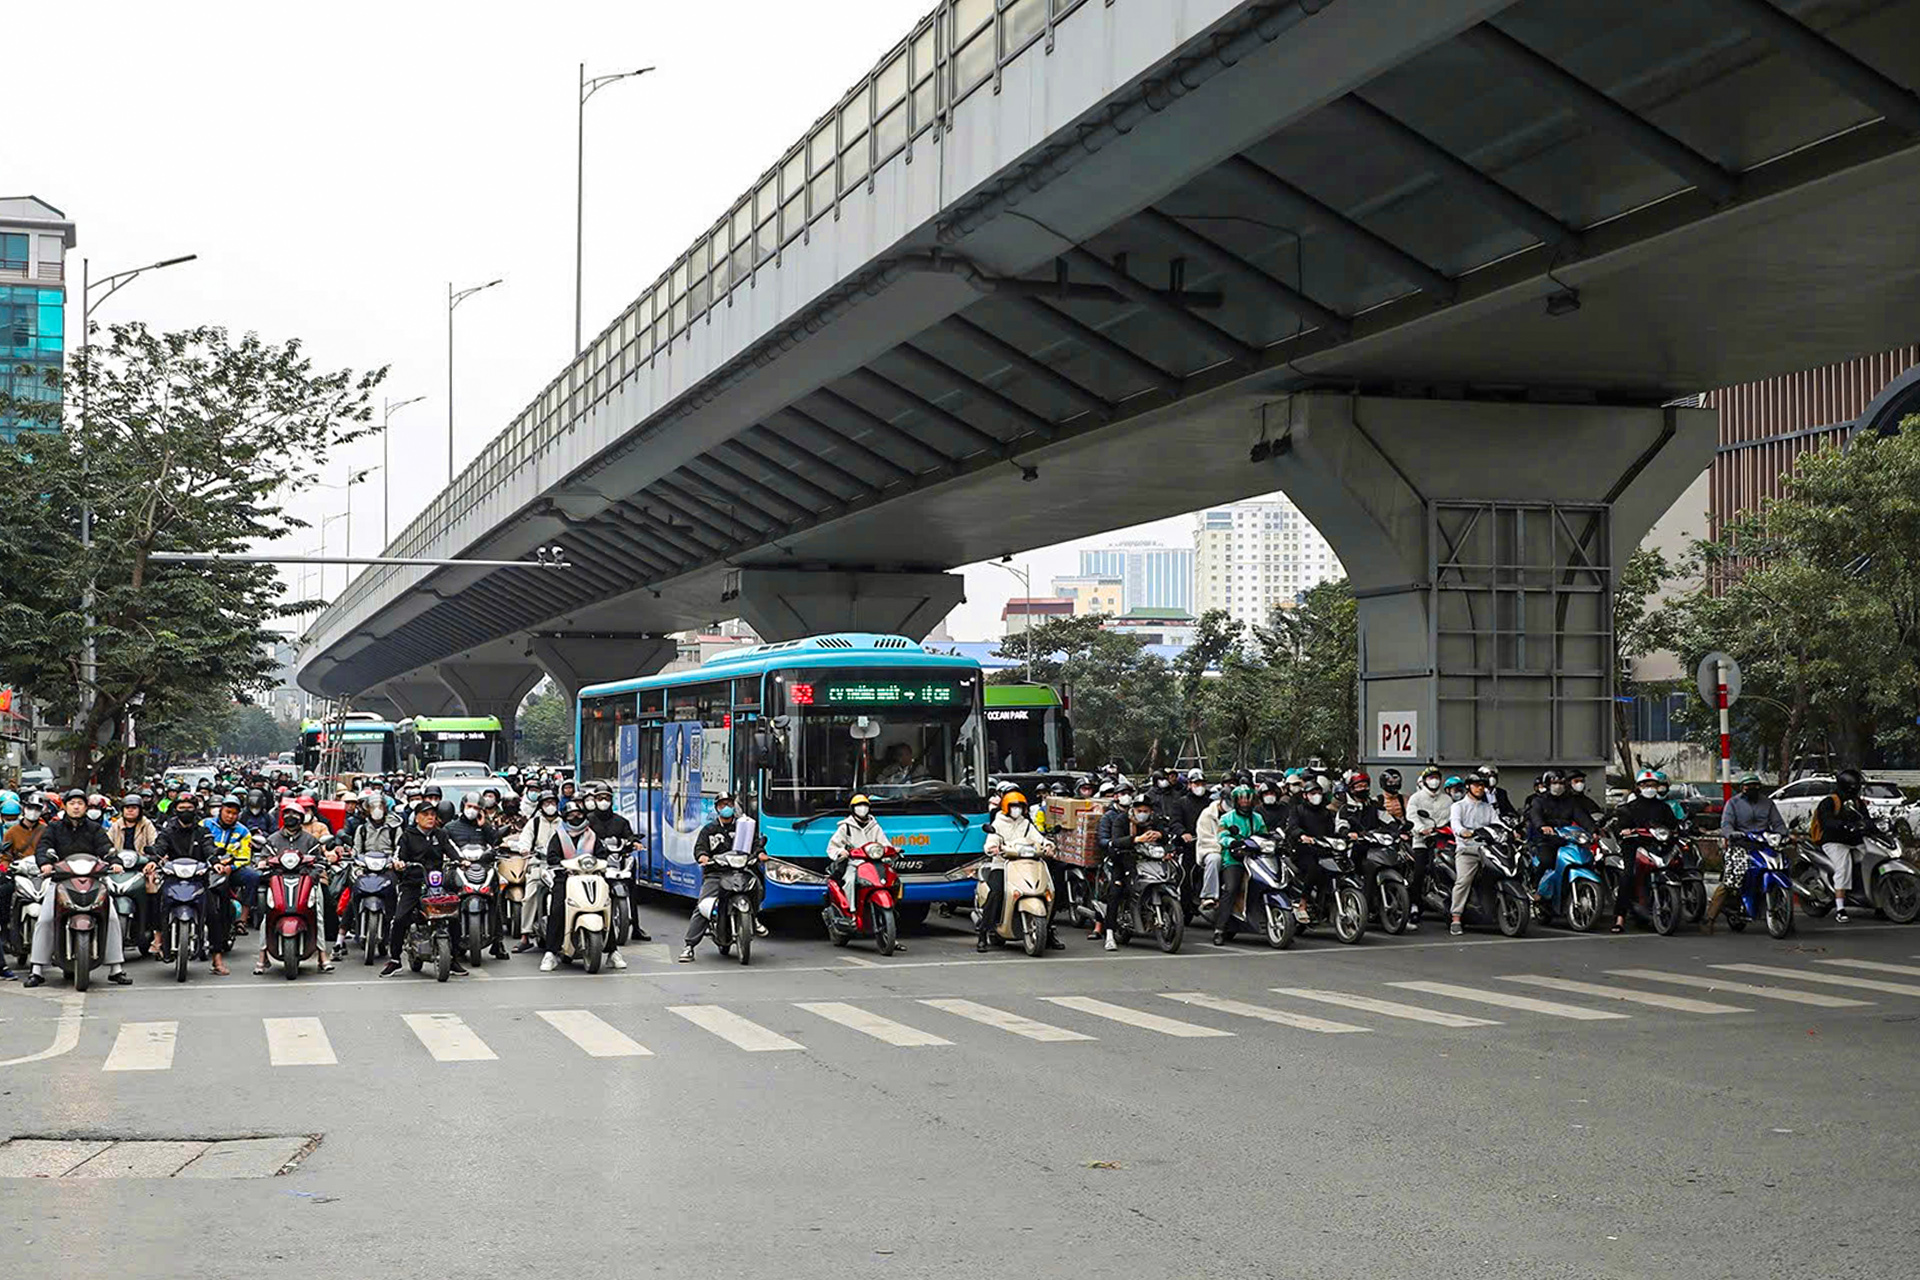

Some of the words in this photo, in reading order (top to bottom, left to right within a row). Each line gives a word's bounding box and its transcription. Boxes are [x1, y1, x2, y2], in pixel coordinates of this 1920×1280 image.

[987, 710, 1010, 720] OCEAN
[1010, 710, 1029, 720] PARK
[1382, 723, 1412, 751] P12
